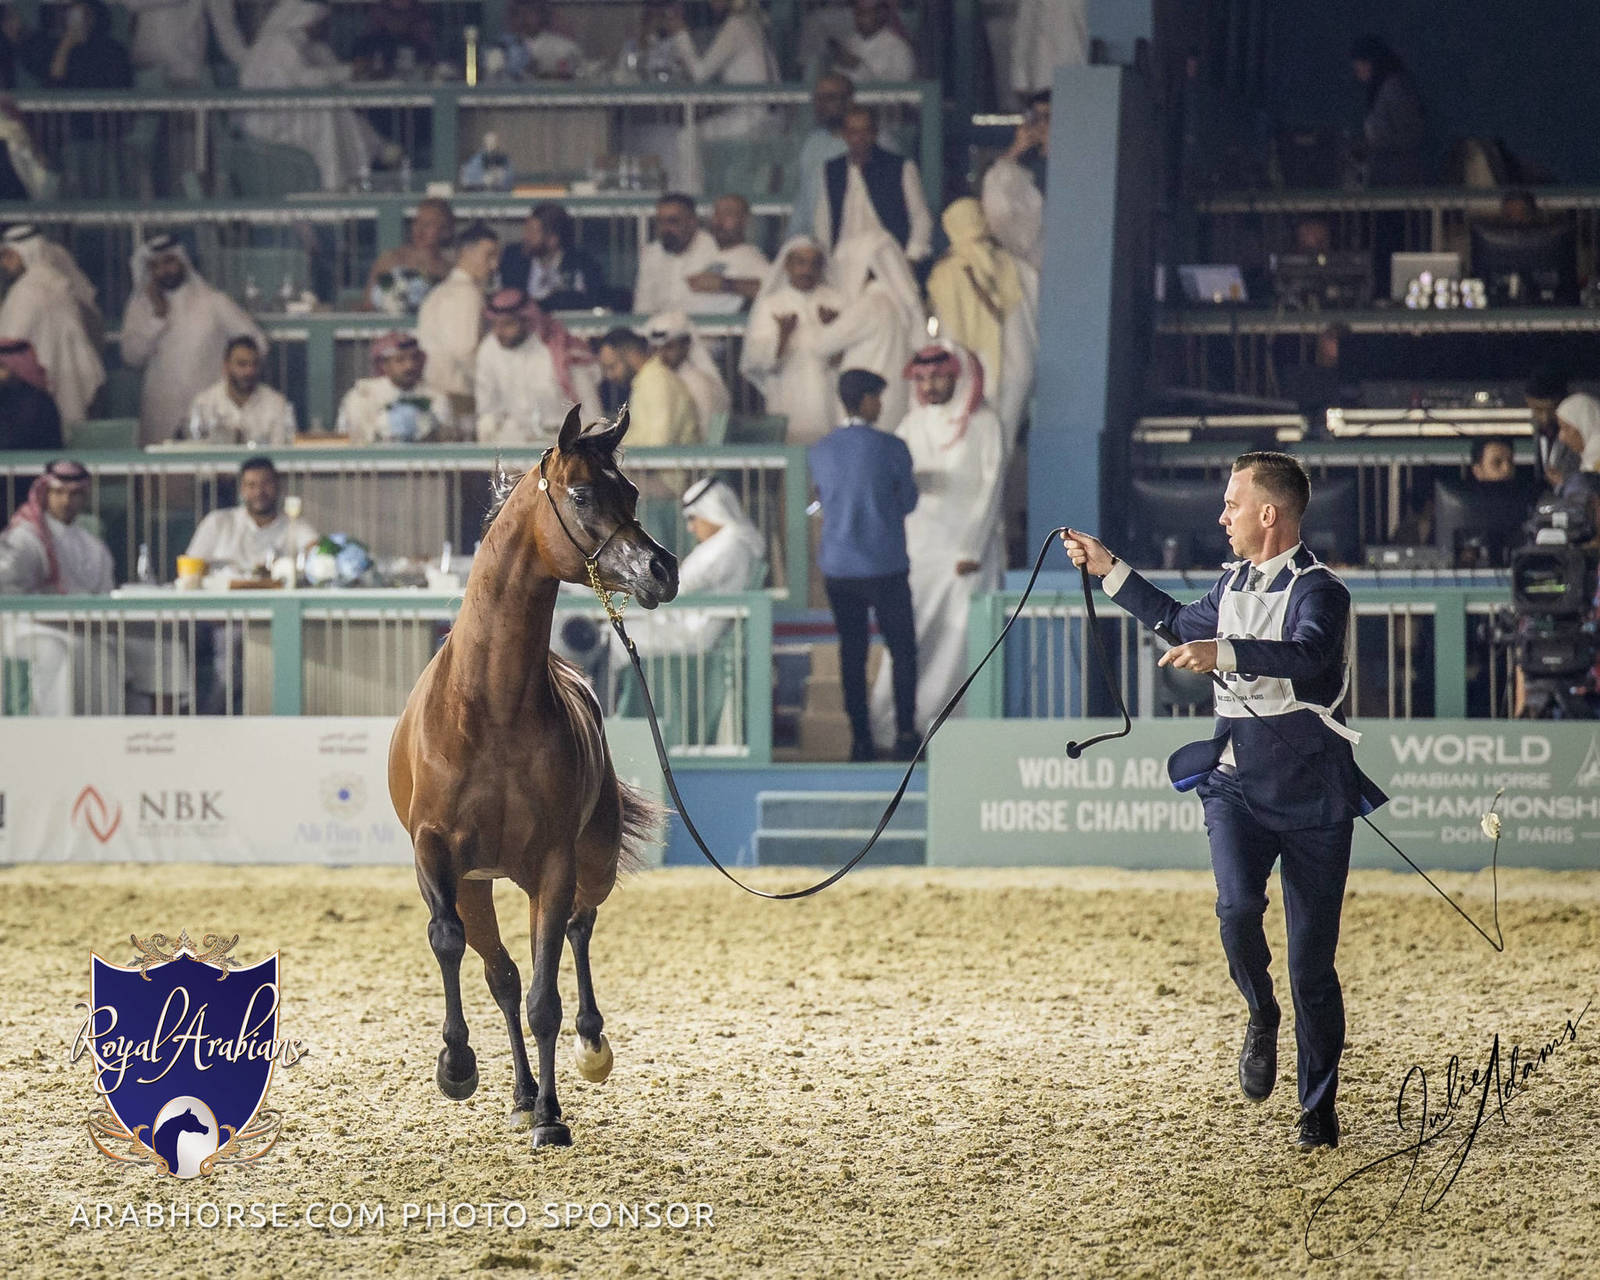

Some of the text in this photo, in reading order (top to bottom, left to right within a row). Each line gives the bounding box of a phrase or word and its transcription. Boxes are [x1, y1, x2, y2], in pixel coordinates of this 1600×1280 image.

[1391, 735, 1551, 764] WORLD
[1018, 757, 1115, 789] WORLD
[1389, 772, 1551, 789] ARABIAN HORSE
[139, 791, 226, 821] NBK
[979, 800, 1069, 832] HORSE
[1518, 827, 1574, 843] PARIS
